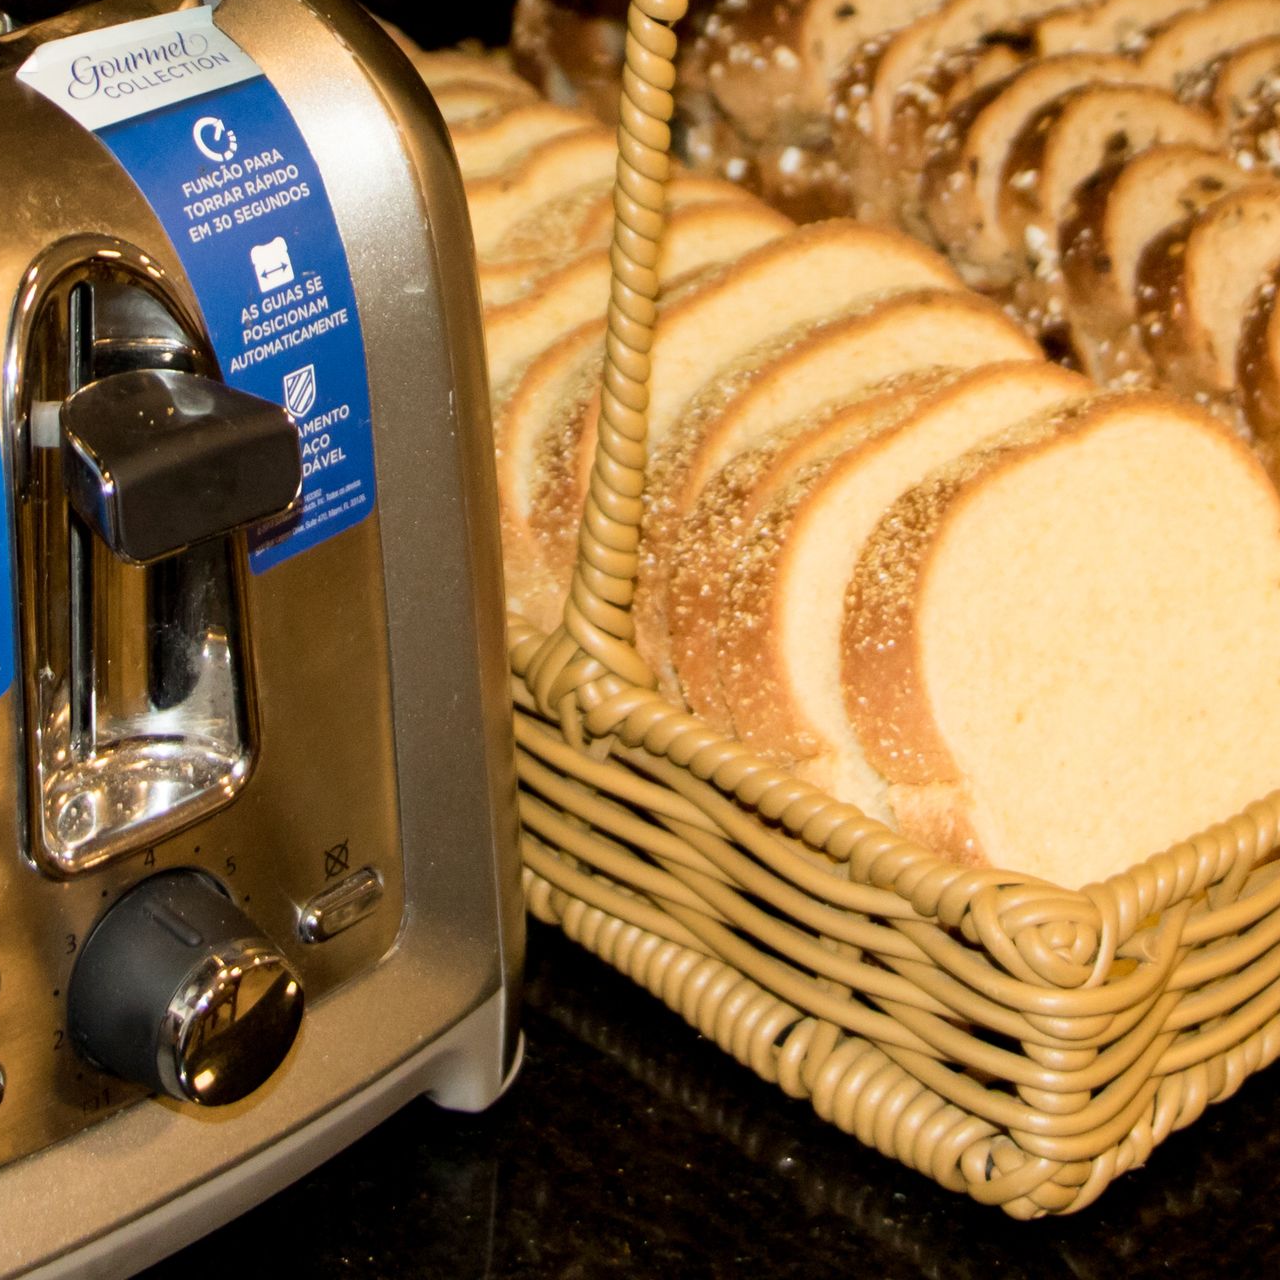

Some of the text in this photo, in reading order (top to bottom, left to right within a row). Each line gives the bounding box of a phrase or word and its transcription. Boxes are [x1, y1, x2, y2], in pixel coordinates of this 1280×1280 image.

[68, 32, 208, 100] Gourmet
[104, 52, 231, 99] COLLECTION
[182, 148, 283, 198] FUNÇÃO PARA
[184, 165, 298, 220] TORRAR RÁPIDO
[189, 183, 310, 243] EM 30 SEGUNDOS
[241, 277, 323, 323] AS GUIAS SE
[243, 296, 328, 344] POSICIONAM
[230, 309, 348, 372] AUTOMATICAMENTE
[297, 404, 349, 438] AMENTO
[302, 434, 330, 457] AÇO
[303, 448, 346, 477] DÁVEL
[144, 848, 156, 867] 4
[226, 856, 236, 876] 5
[66, 934, 77, 954] 3
[54, 1030, 64, 1050] 2
